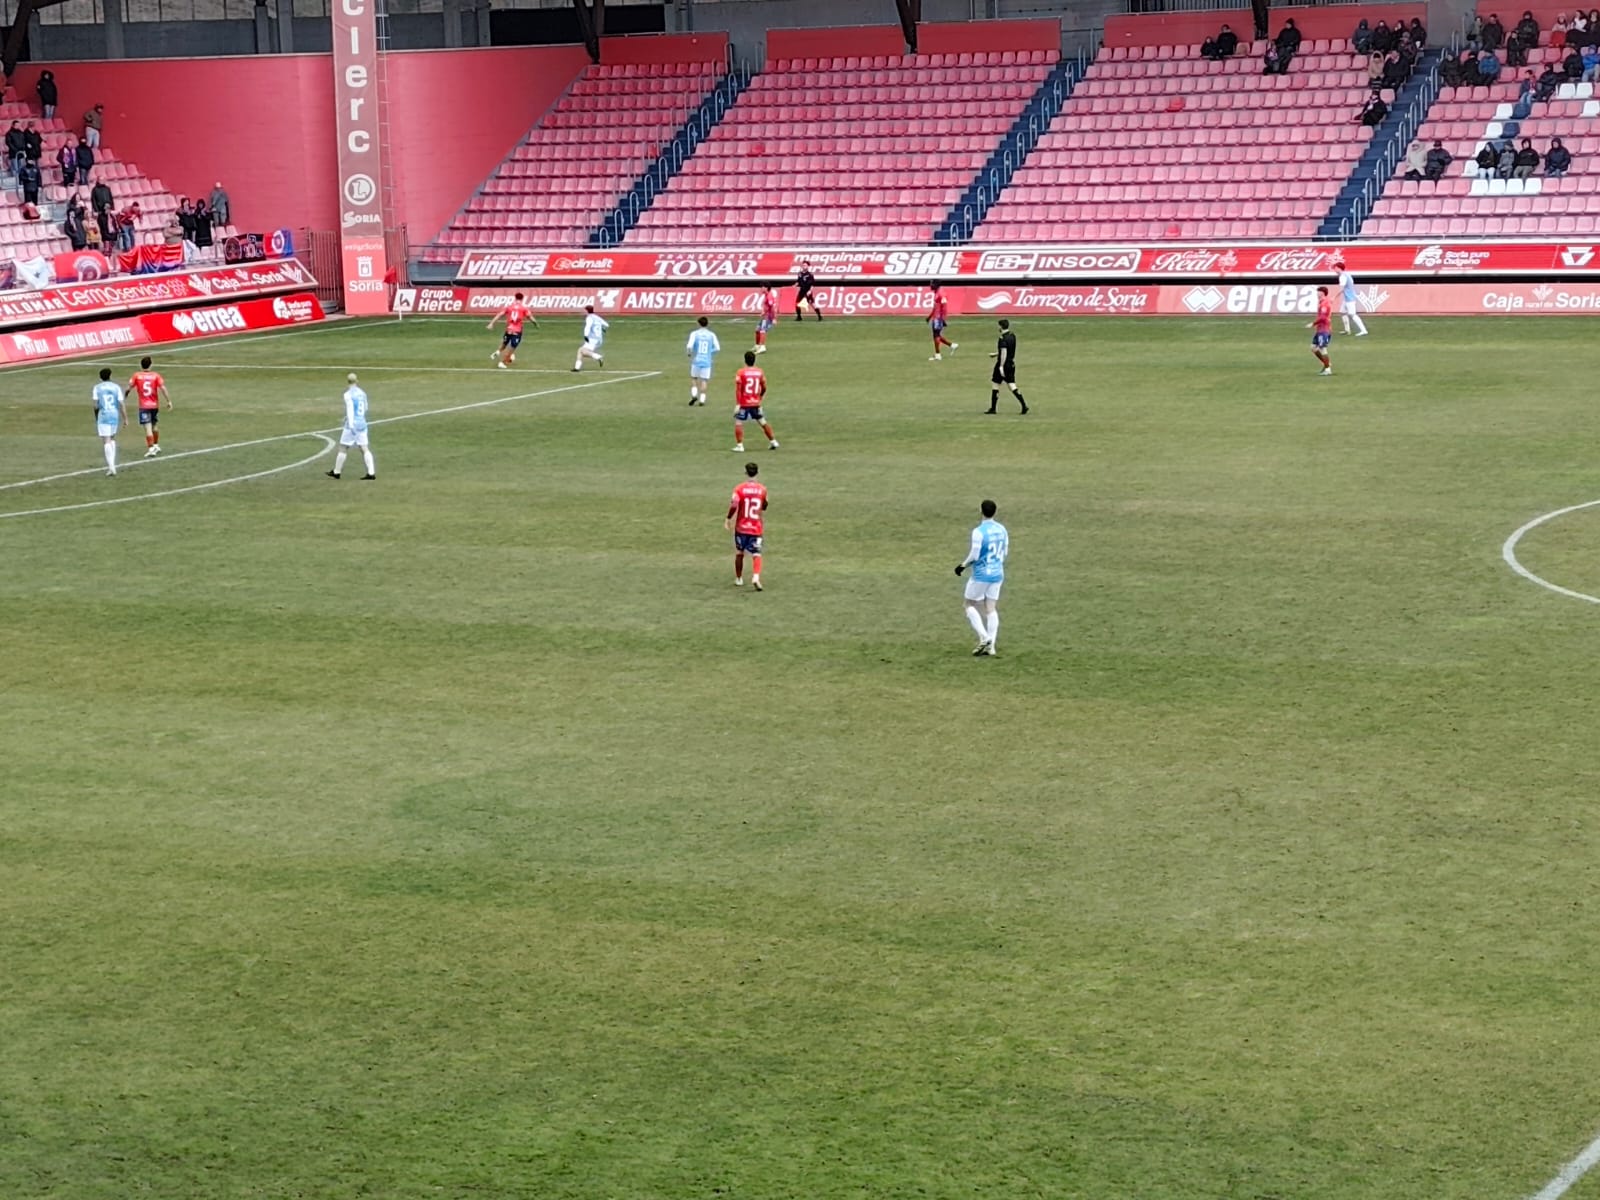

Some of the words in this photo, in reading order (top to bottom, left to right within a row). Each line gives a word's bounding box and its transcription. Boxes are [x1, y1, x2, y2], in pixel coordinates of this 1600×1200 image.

[467, 256, 548, 275] vinuesa
[654, 260, 758, 276] TOVAR
[794, 252, 885, 266] maquinaria
[1038, 255, 1134, 269] INSOCA
[1151, 252, 1220, 271] Real
[1256, 251, 1327, 271] Real
[349, 280, 383, 292] Soria
[421, 288, 453, 301] Grupo
[0, 297, 65, 316] ALOMAR
[418, 298, 462, 311] Herce
[624, 291, 695, 309] AMSTEL
[701, 289, 734, 306] Oro
[814, 286, 935, 314] eligeSoria
[1103, 287, 1147, 308] Soria
[1483, 292, 1524, 312] Caja
[143, 381, 152, 396] 5
[745, 378, 760, 393] 21
[744, 498, 761, 519] 12
[987, 541, 1004, 563] 24
